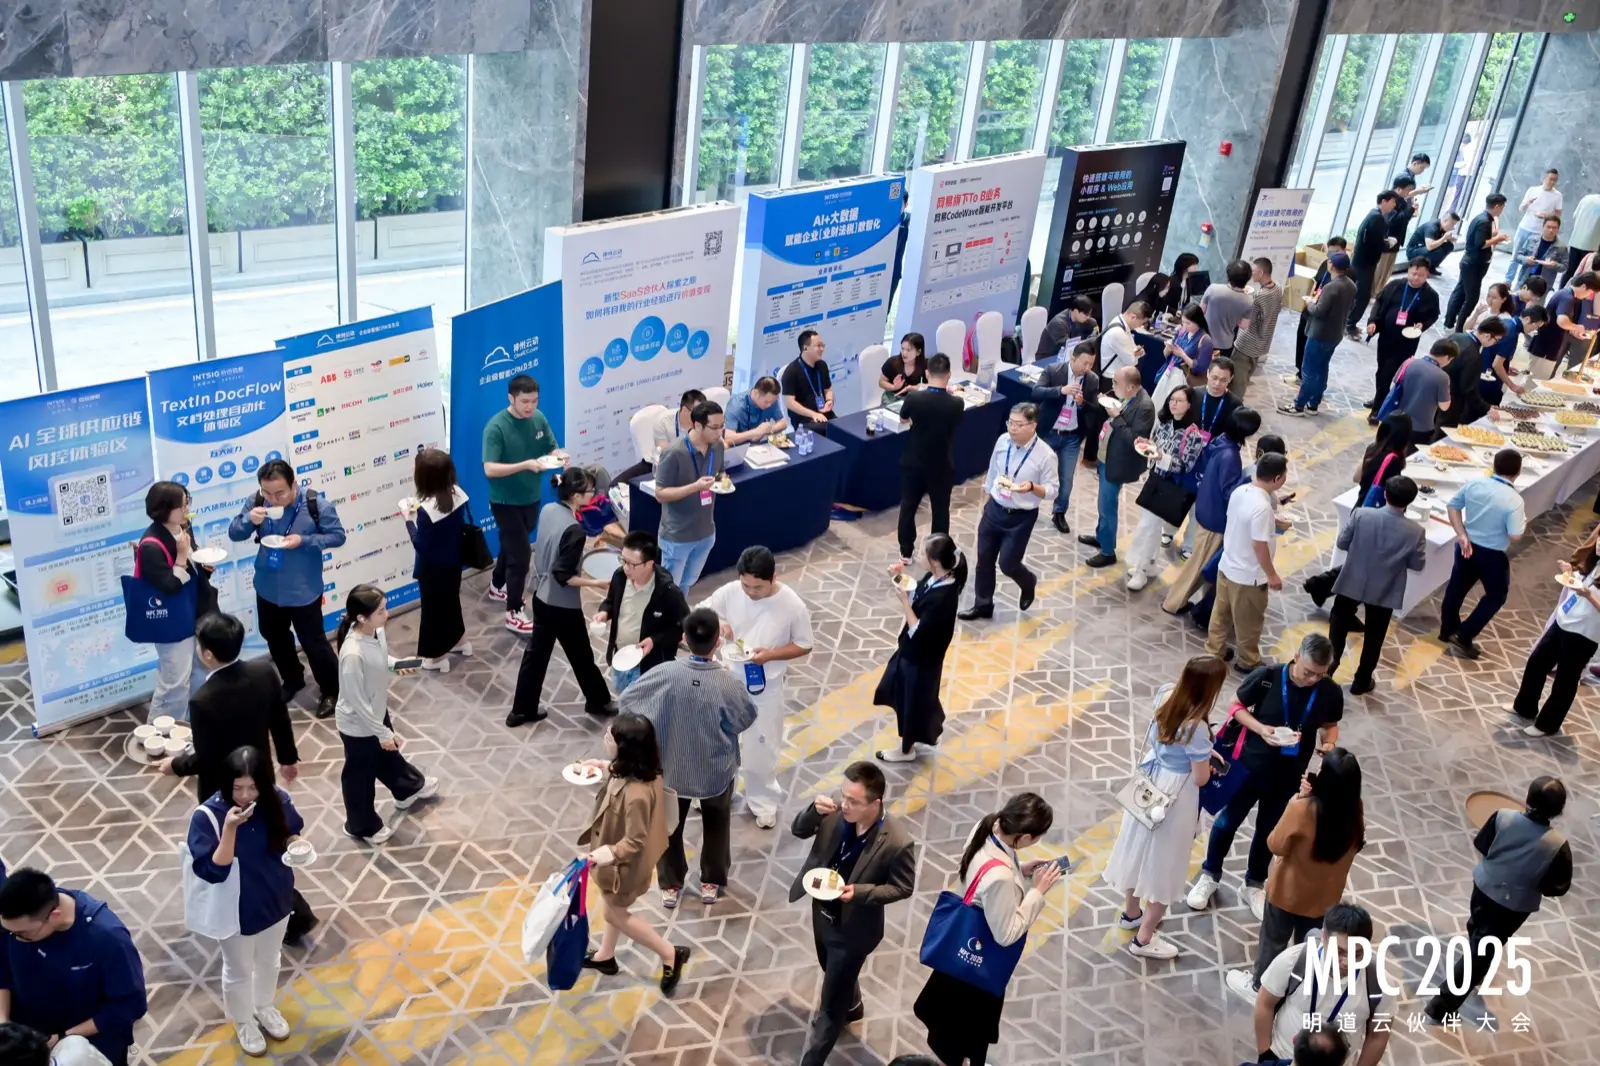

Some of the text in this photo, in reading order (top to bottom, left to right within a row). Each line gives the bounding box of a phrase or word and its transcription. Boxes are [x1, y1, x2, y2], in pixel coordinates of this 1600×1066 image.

[812, 206, 860, 227] AI+大数据
[192, 370, 220, 382] INTSIG
[320, 373, 337, 385] ABB
[416, 380, 434, 390] Haier
[160, 380, 282, 414] TextIn DocFlow
[176, 400, 266, 428] 文档处理自动化
[8, 410, 143, 452] AI 全球供应链
[203, 415, 243, 434] 体验区
[28, 436, 129, 472] 风控体验区
[968, 952, 984, 965] 2025
